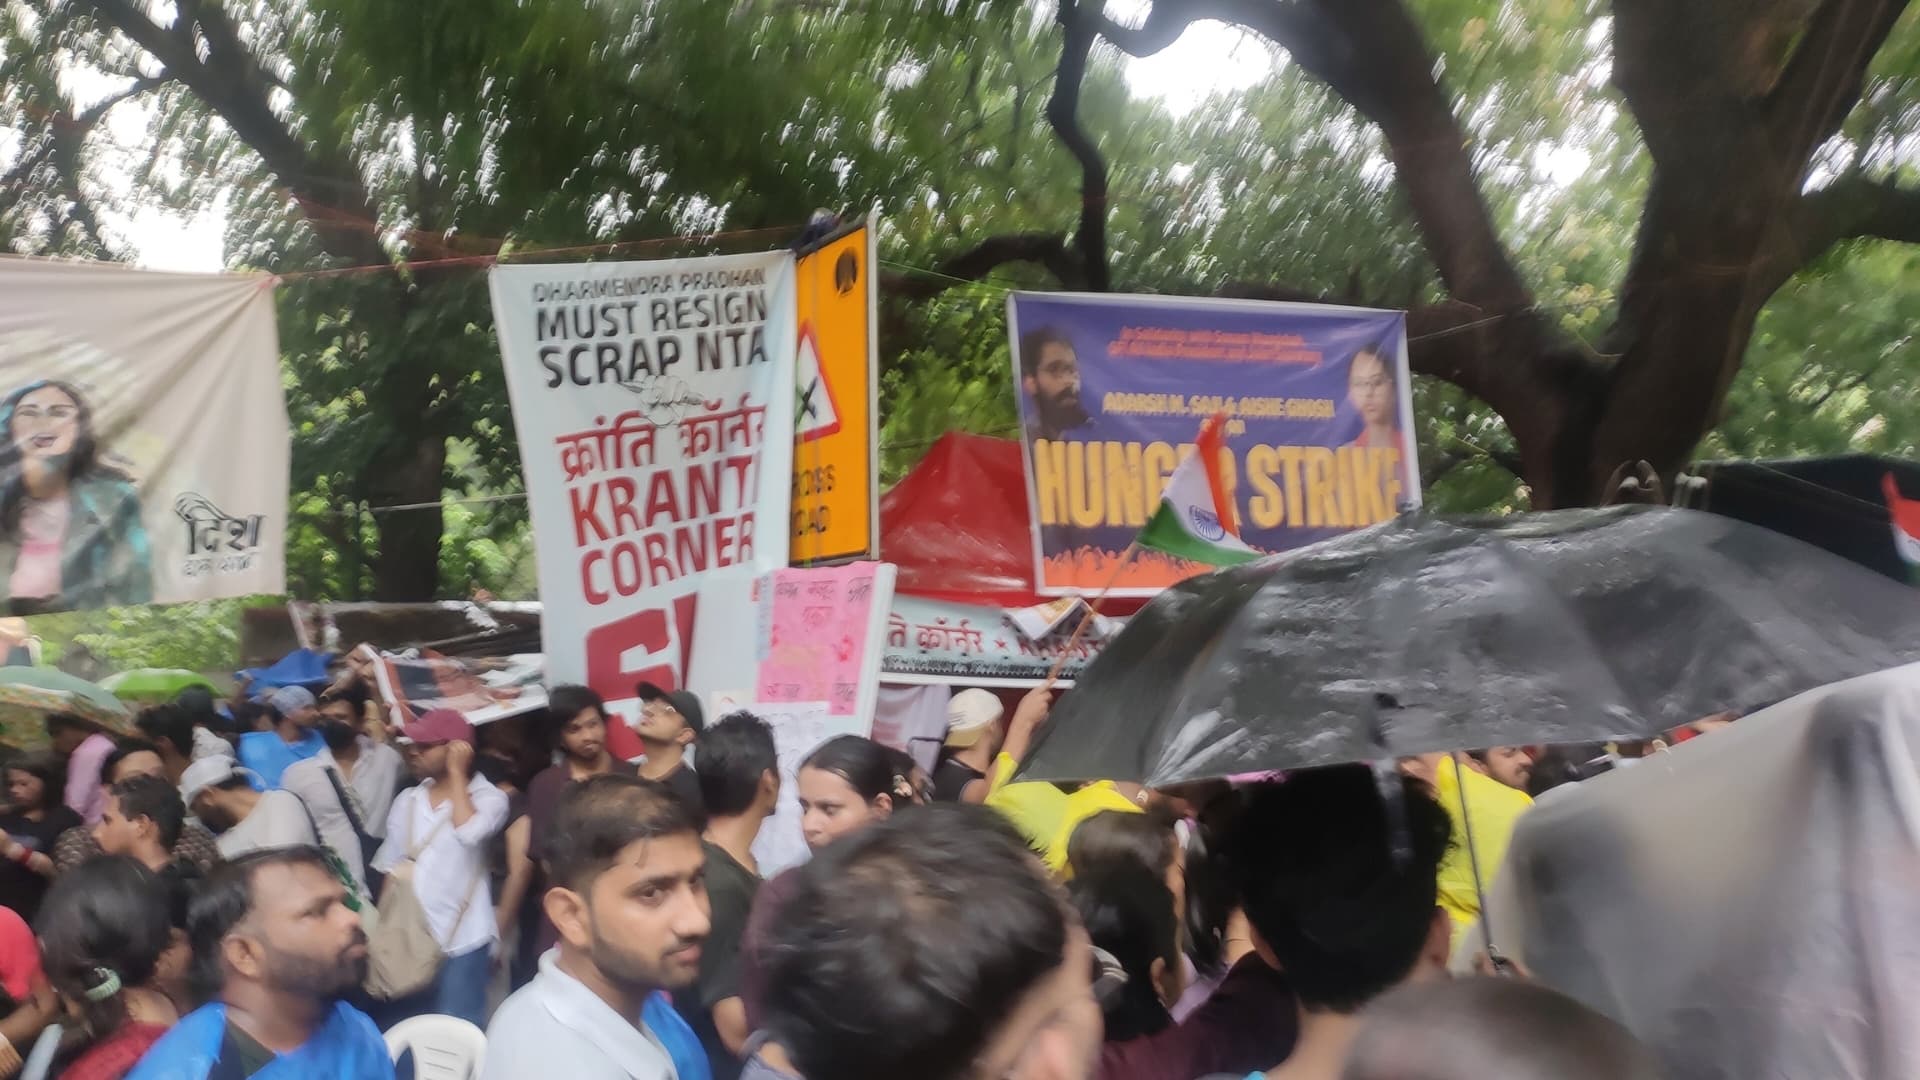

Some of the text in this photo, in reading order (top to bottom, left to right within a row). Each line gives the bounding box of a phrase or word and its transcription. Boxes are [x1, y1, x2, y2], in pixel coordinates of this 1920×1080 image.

[534, 268, 766, 302] DHARMENDRA PRADHAN
[536, 289, 768, 341] MUST RESIGN
[539, 326, 768, 388] SCRAP NTA
[555, 409, 656, 482] क्रांति
[1247, 443, 1401, 529] STRIKE
[581, 511, 755, 605] CORNER
[916, 616, 984, 653] कॉर्नर
